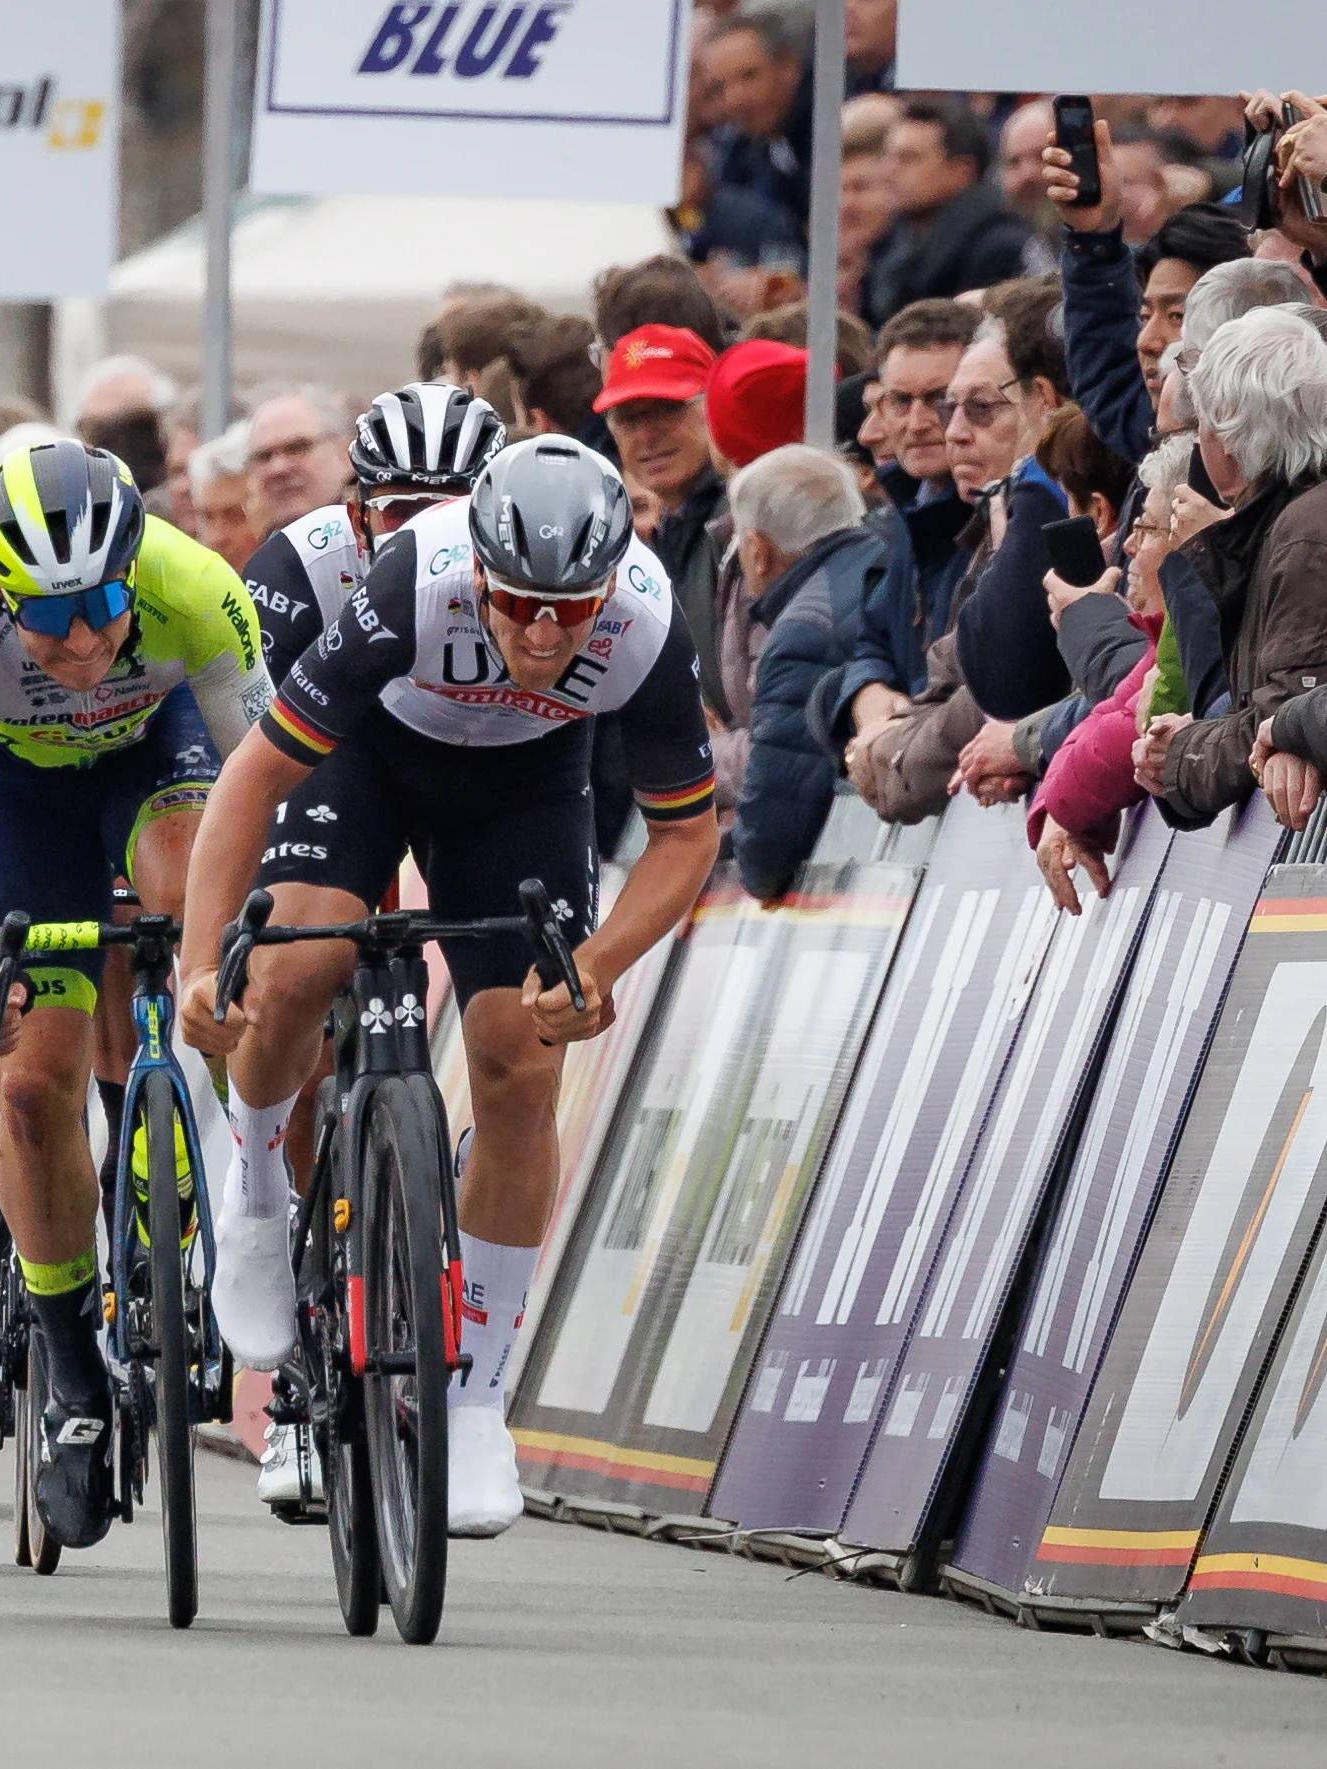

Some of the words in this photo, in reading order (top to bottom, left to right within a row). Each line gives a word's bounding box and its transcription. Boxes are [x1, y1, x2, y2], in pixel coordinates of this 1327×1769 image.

[356, 0, 572, 78] BLUE
[411, 473, 451, 485] MET
[498, 494, 517, 557] MET
[538, 523, 565, 540] G42
[429, 543, 471, 576] G42
[51, 576, 84, 591] uvex
[220, 591, 256, 671] Wallonie
[241, 679, 271, 708] PIERRE
[442, 641, 609, 703] UE
[147, 1002, 161, 1059] CUBE
